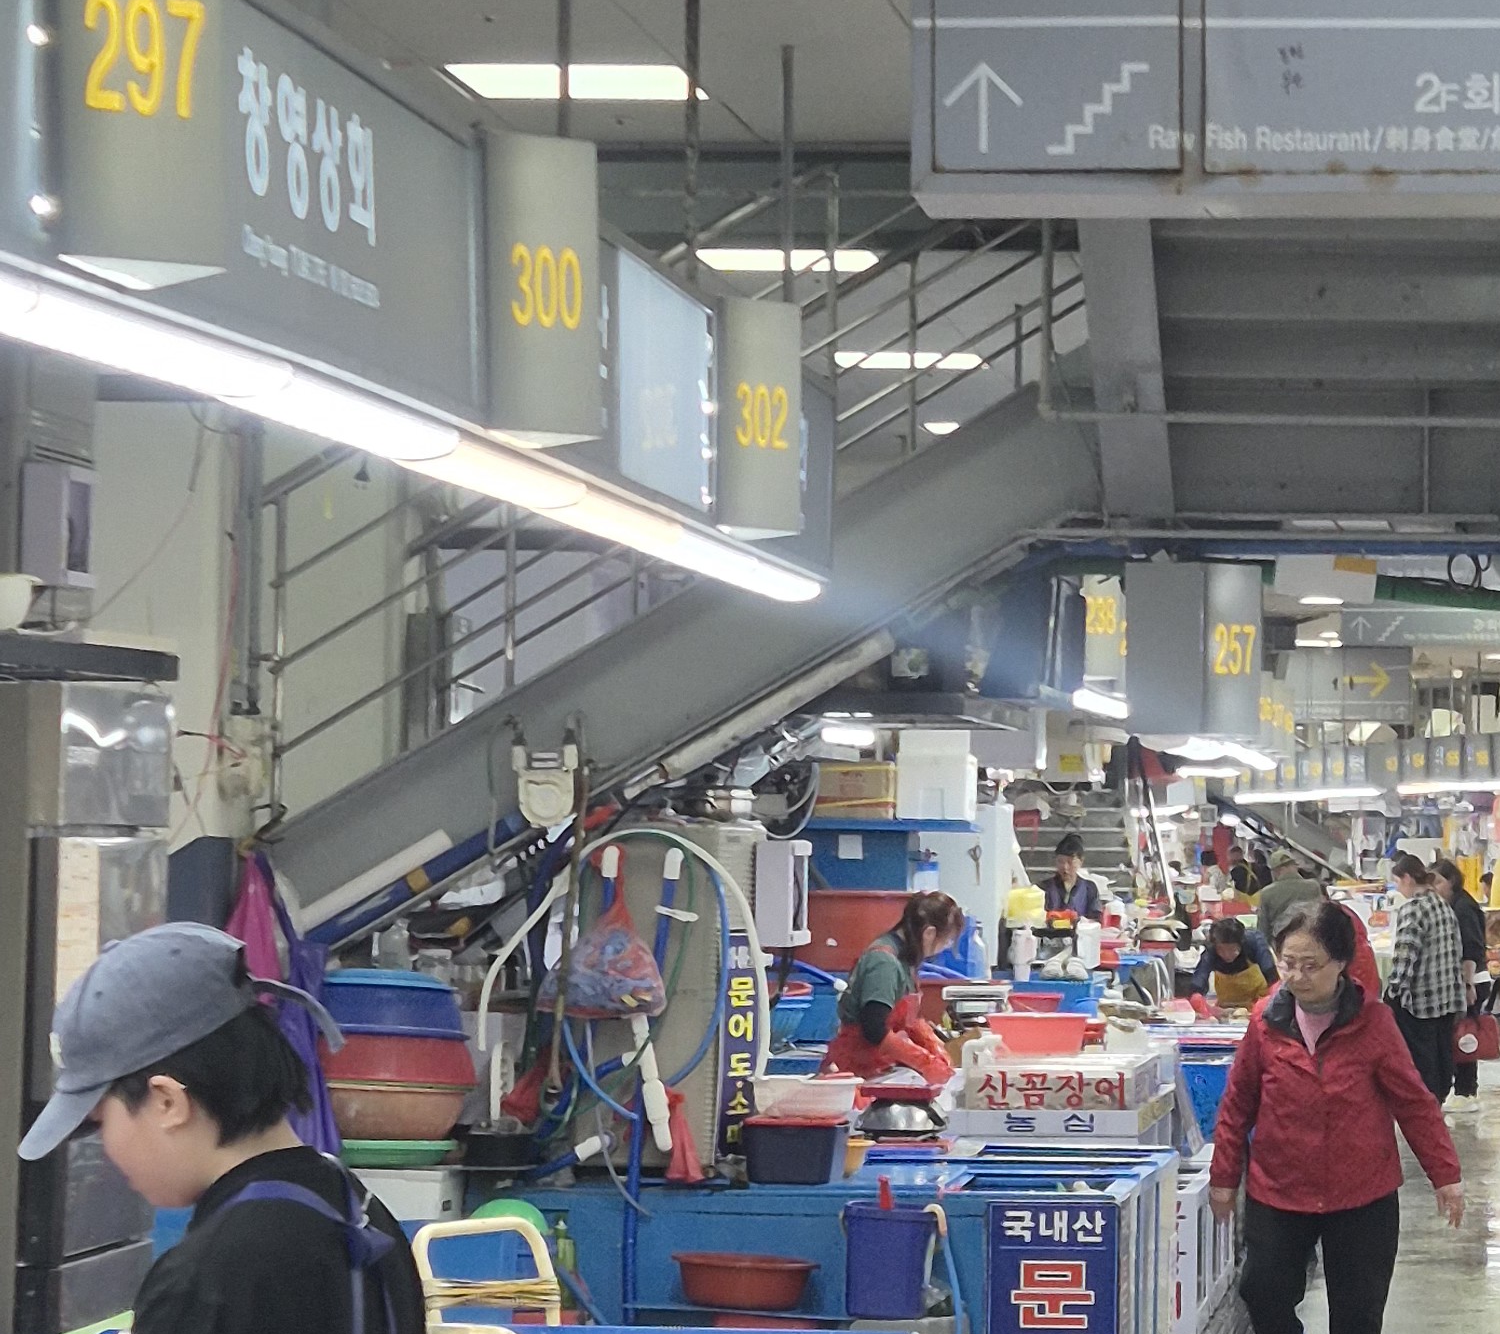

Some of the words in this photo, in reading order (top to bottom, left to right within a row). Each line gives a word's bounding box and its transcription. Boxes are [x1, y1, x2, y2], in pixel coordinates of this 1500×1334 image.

[236, 46, 377, 248] 창영상회
[1149, 124, 1195, 151] Raw
[1206, 122, 1247, 151] Fish
[511, 242, 582, 330] 300
[736, 381, 789, 450] 302
[1213, 622, 1256, 676] 257
[728, 976, 755, 1041] 문어
[977, 1071, 1126, 1110] 산꼼장어
[1001, 1210, 1107, 1243] 국내산
